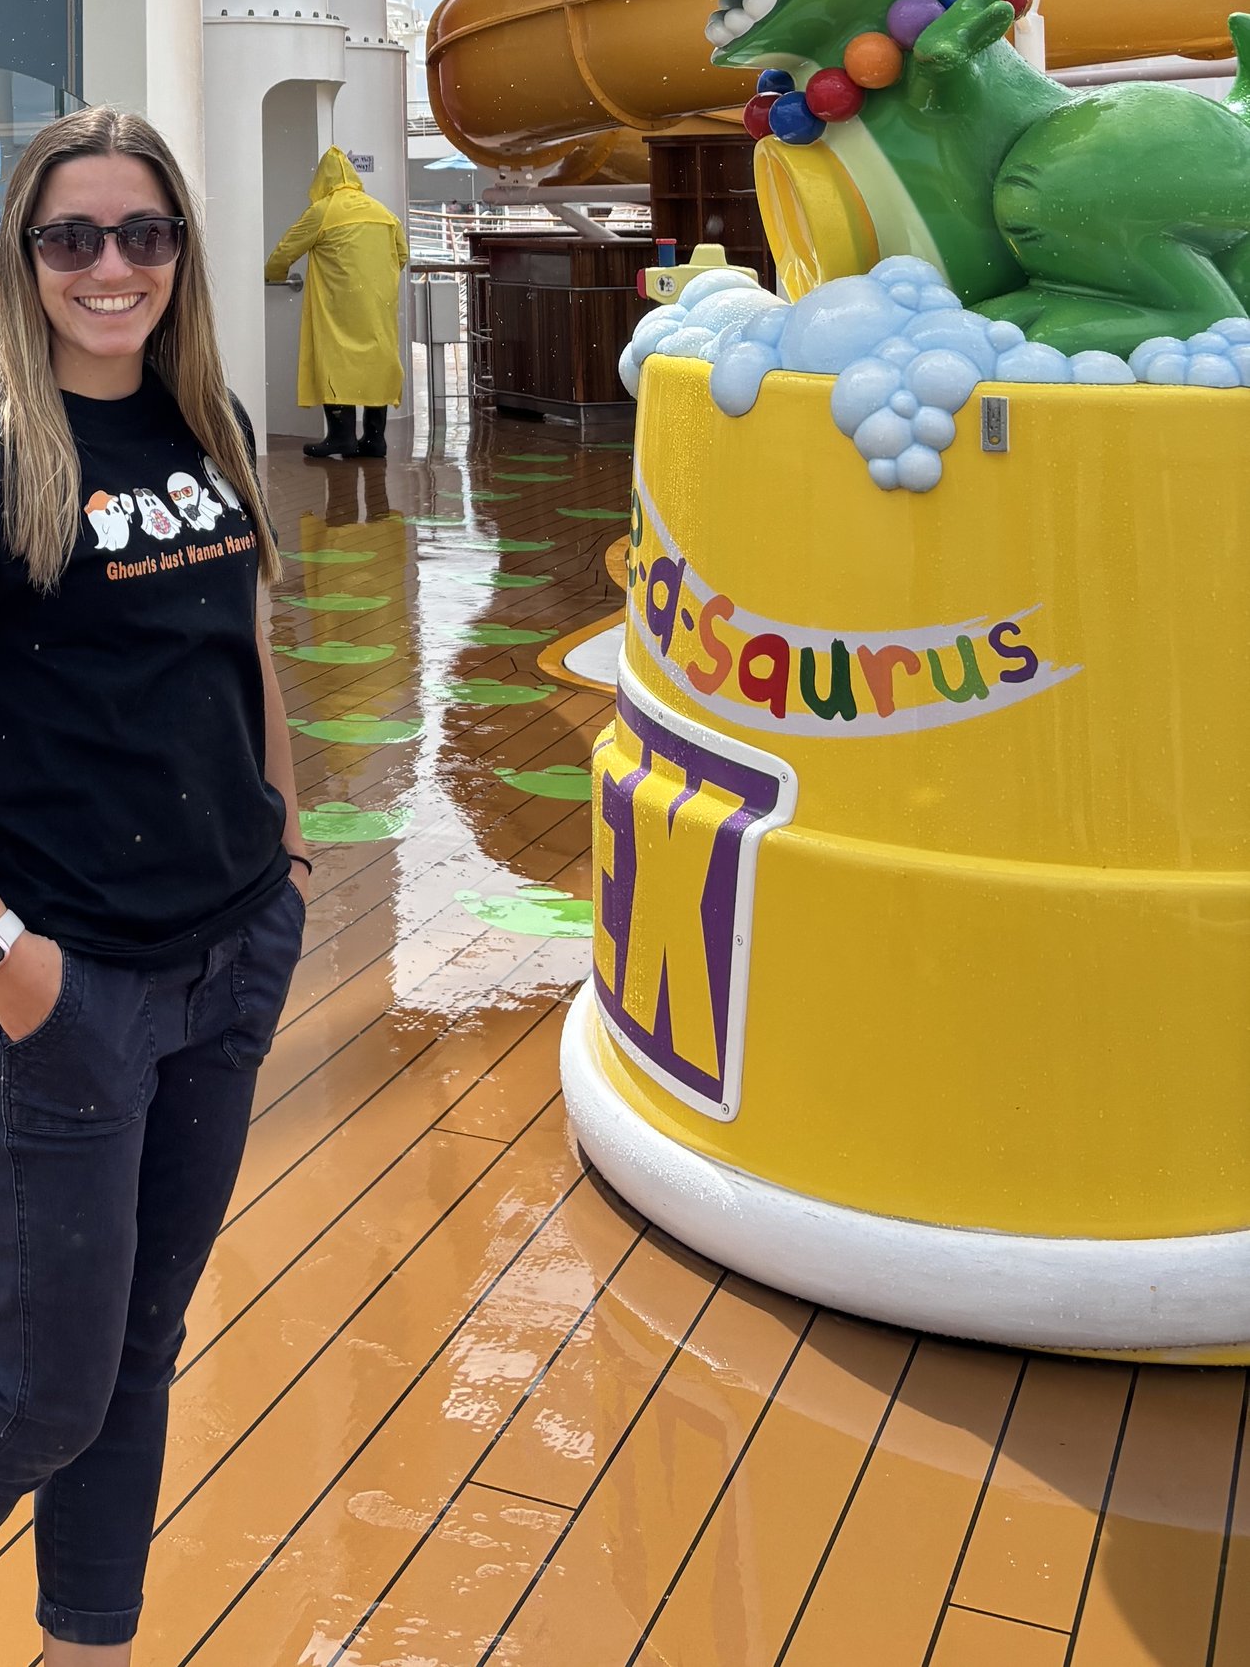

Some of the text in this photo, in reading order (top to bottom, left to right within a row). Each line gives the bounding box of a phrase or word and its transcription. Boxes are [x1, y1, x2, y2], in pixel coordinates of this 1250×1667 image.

[160, 549, 184, 570] Just
[186, 544, 225, 564] Wanna
[225, 535, 251, 554] Have
